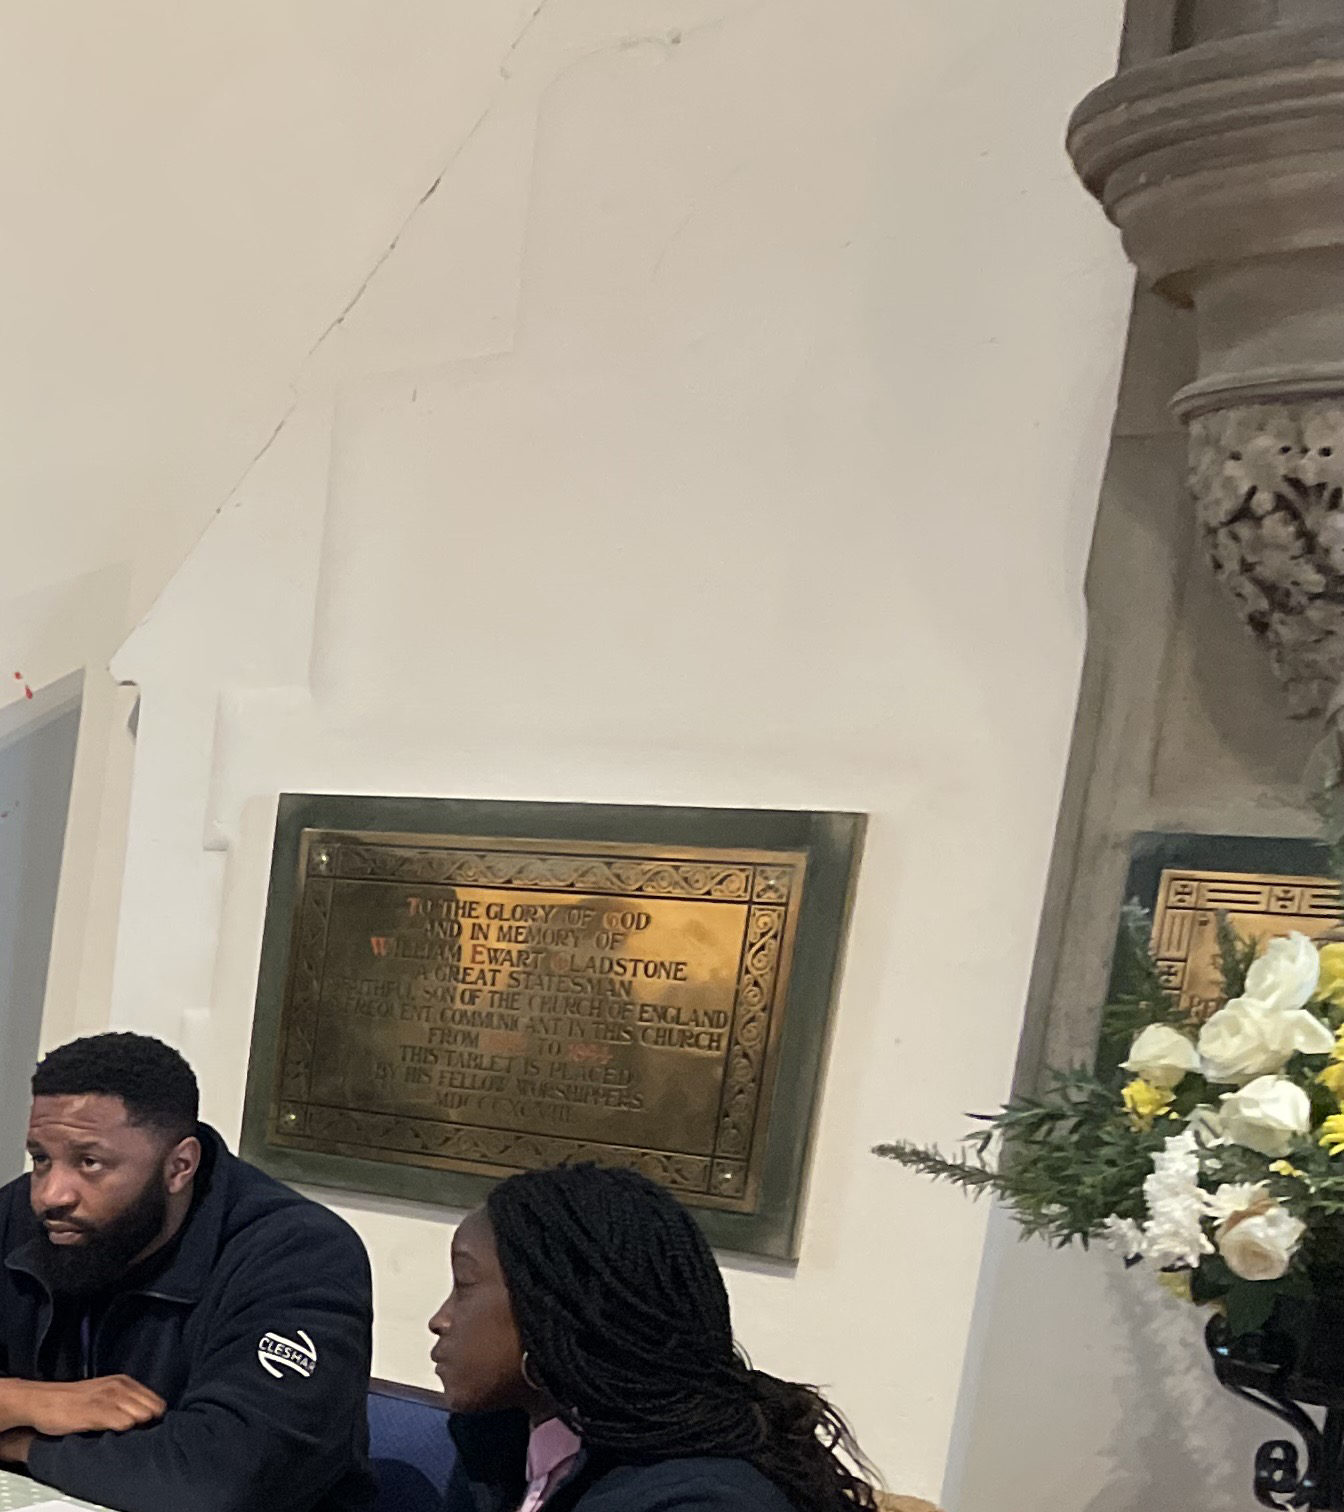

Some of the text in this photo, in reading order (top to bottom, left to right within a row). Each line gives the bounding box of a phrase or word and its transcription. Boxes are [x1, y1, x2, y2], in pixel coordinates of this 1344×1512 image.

[407, 897, 652, 931] TO THE GLORY OF GOD
[425, 919, 627, 951] AND IN MEMORY OF
[371, 936, 689, 982] WILLIAM EWART GLADSTONE
[434, 965, 502, 988] GREAT
[507, 969, 633, 998] STATESMAN
[423, 985, 457, 1005] SON
[459, 988, 482, 1007] OF
[487, 989, 521, 1011] THE
[527, 994, 602, 1018] CHURCH
[608, 1001, 636, 1021] OF
[638, 1003, 729, 1030] ENGLAND
[427, 1026, 480, 1050] FROM
[536, 1036, 561, 1057] TO
[439, 1007, 562, 1038] COMMUNICANT
[567, 1018, 586, 1038] IN
[592, 1020, 634, 1043] THIS
[641, 1027, 722, 1052] CHURCH
[399, 1044, 634, 1086] THIS TABLET IS PLACED
[437, 1069, 507, 1093] FELLOW
